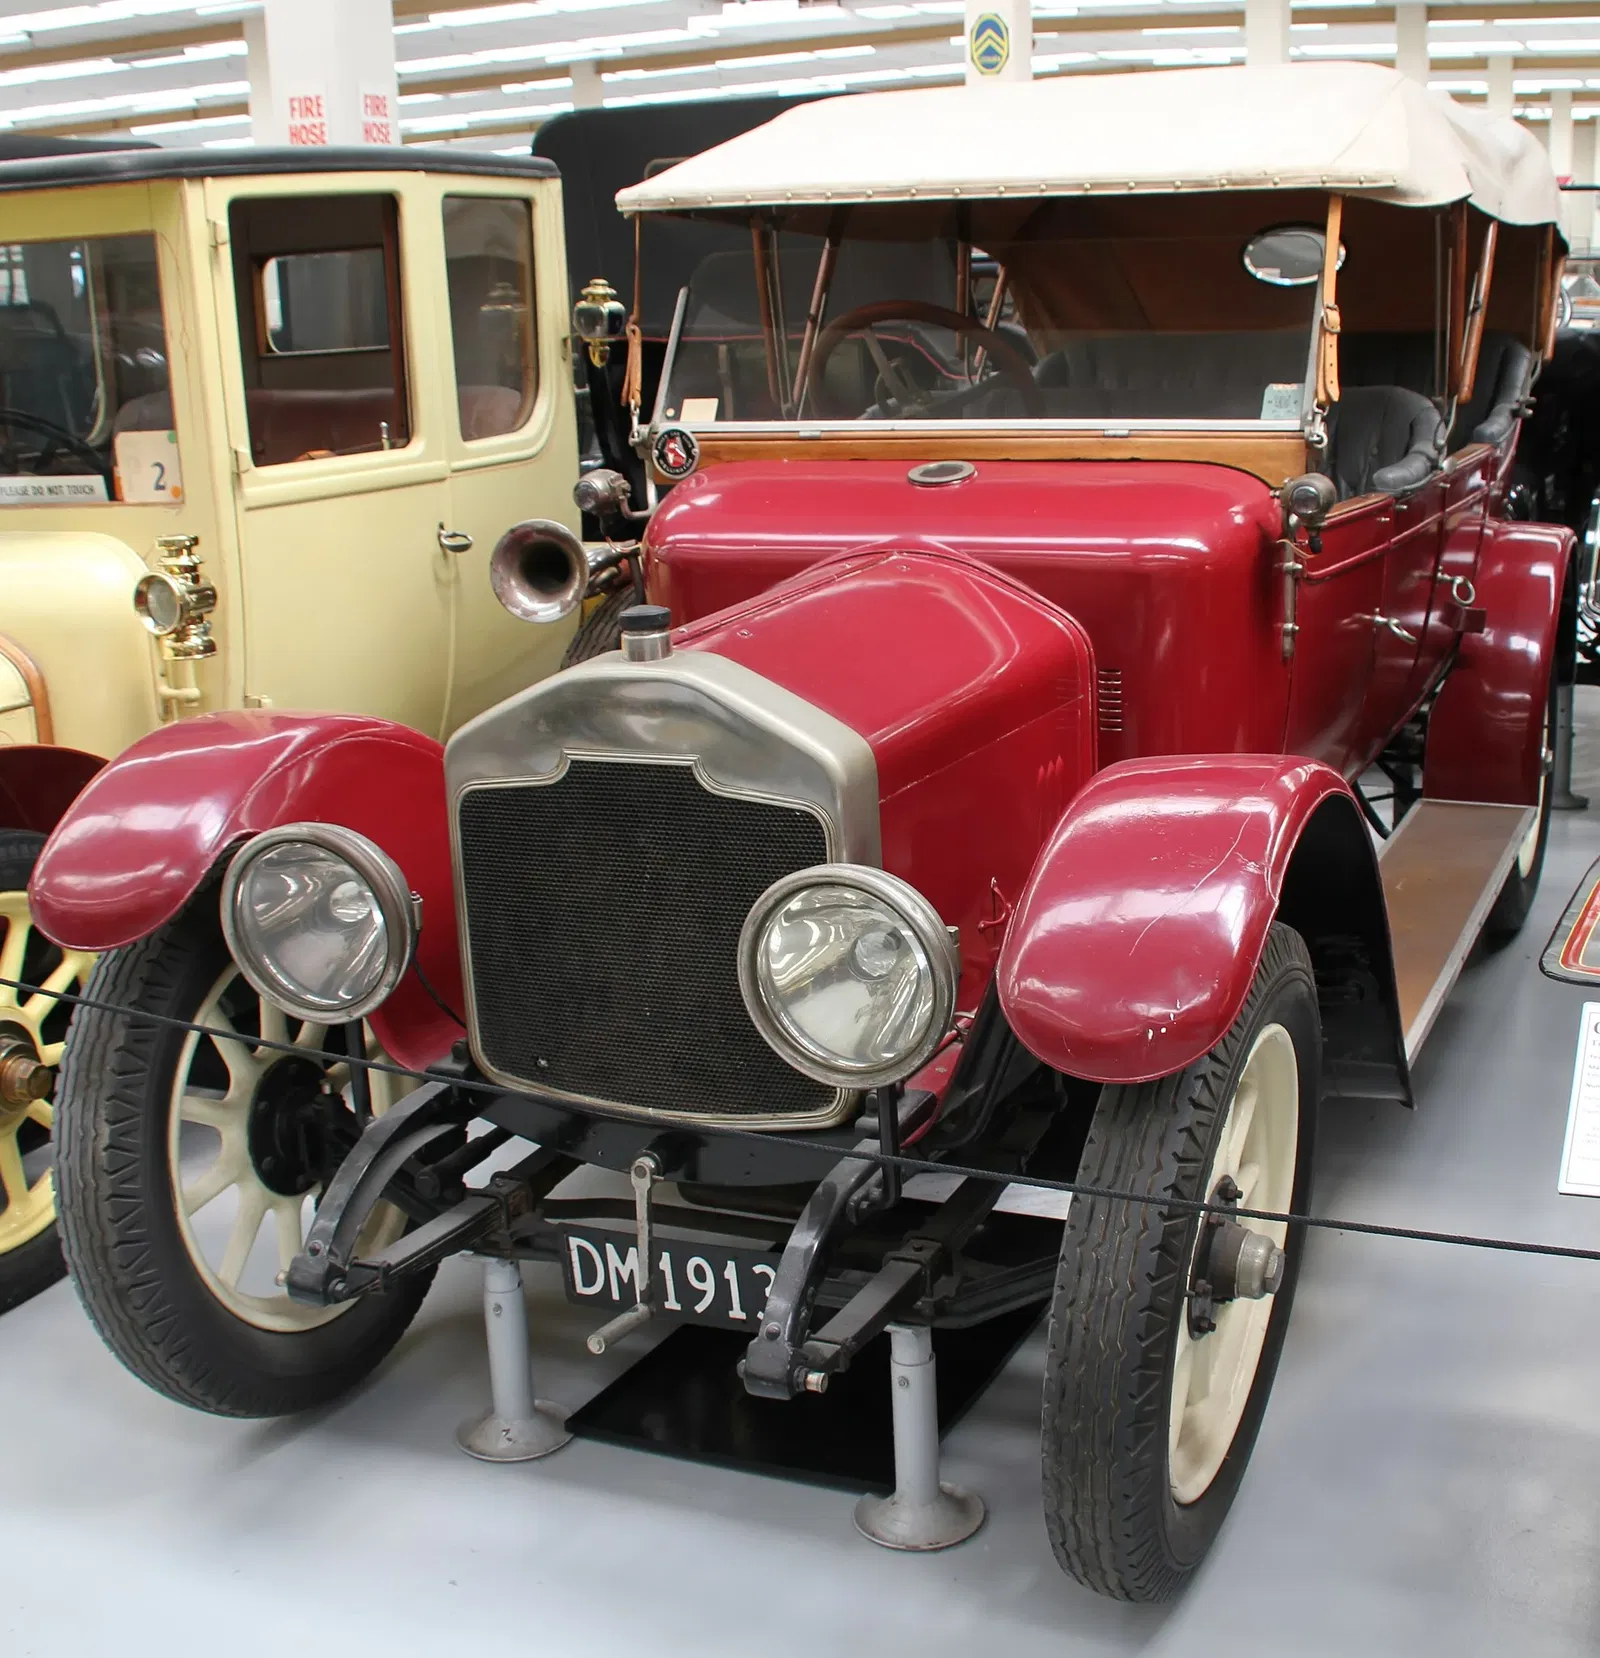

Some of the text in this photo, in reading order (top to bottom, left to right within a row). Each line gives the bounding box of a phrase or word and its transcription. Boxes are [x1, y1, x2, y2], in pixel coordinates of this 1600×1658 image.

[289, 95, 324, 119] FIRE
[363, 93, 388, 118] FIRE
[288, 121, 328, 145] HOSE
[362, 120, 391, 144] HOSE
[150, 461, 166, 491] 2
[31, 485, 44, 496] DO
[47, 484, 65, 496] NOT
[67, 484, 96, 496] TOUCH
